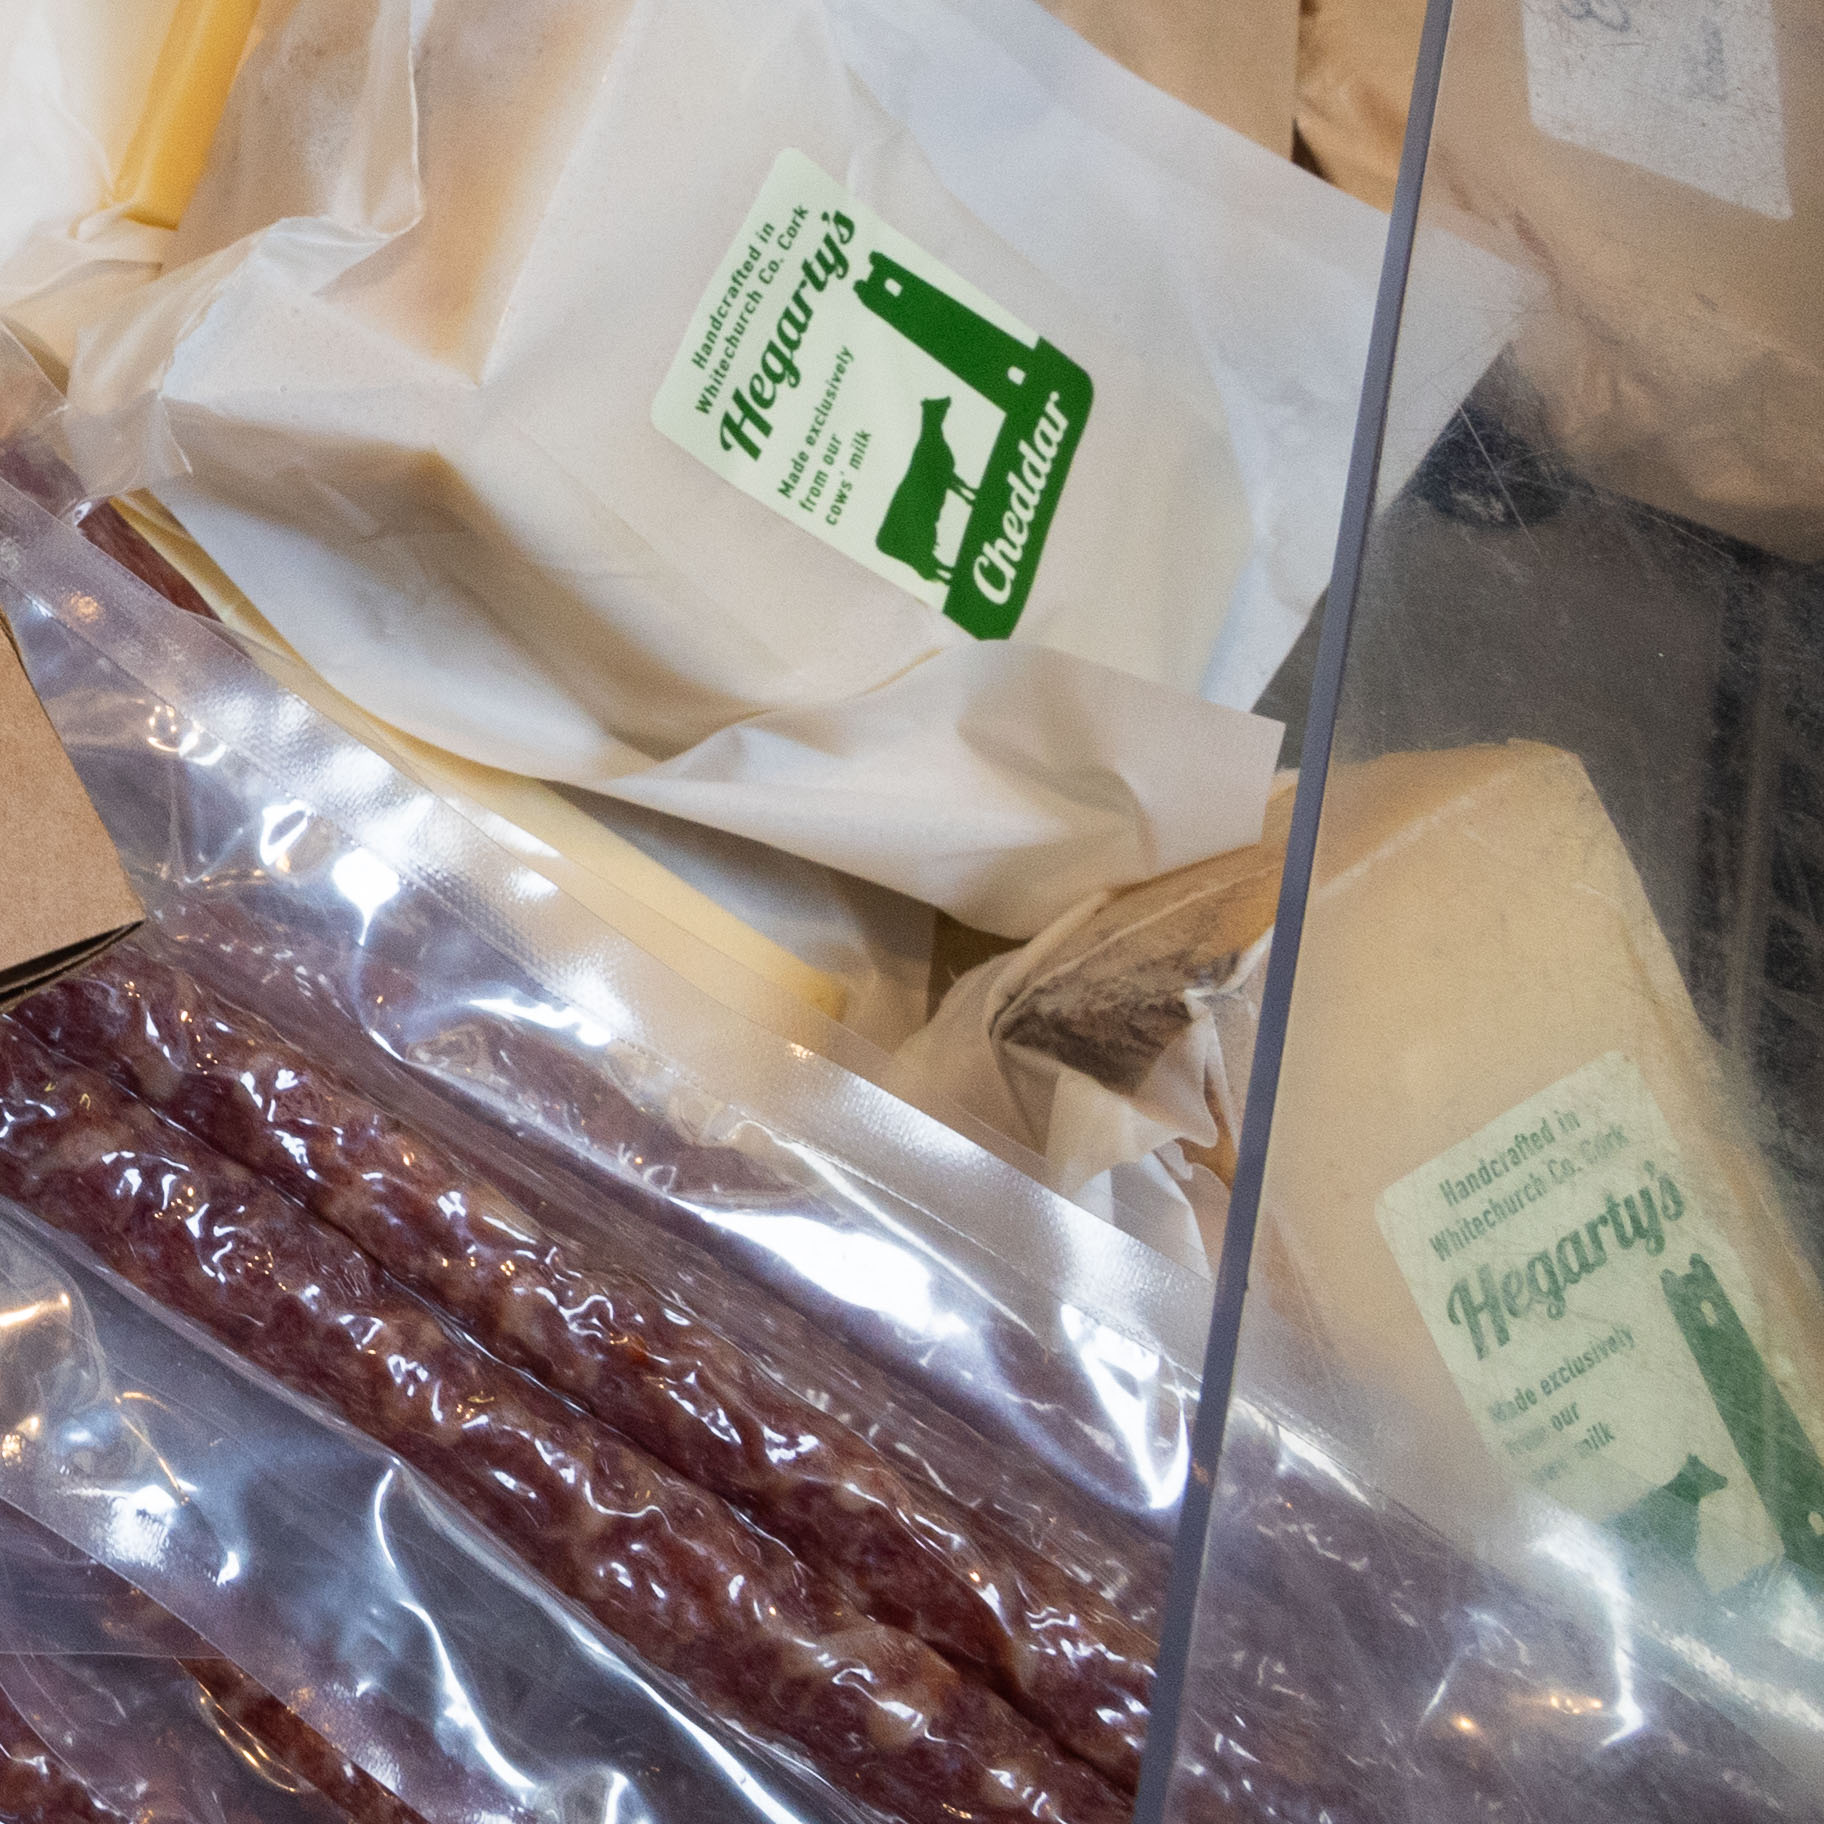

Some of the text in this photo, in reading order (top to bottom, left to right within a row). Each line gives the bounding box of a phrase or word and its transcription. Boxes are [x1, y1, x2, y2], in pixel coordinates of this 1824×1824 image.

[691, 219, 775, 371] Handcrafted in
[694, 203, 809, 417] Whitechurch Co. Cork
[718, 209, 857, 463] Hegarty's
[776, 343, 856, 501] Made exclusively
[799, 431, 843, 514] from our
[848, 426, 873, 471] milk
[972, 389, 1072, 607] Cheddar
[1429, 1172, 1547, 1264] Whitechurch
[1437, 1117, 1558, 1212] Handcrafted
[1446, 1161, 1686, 1364] Hegarty's
